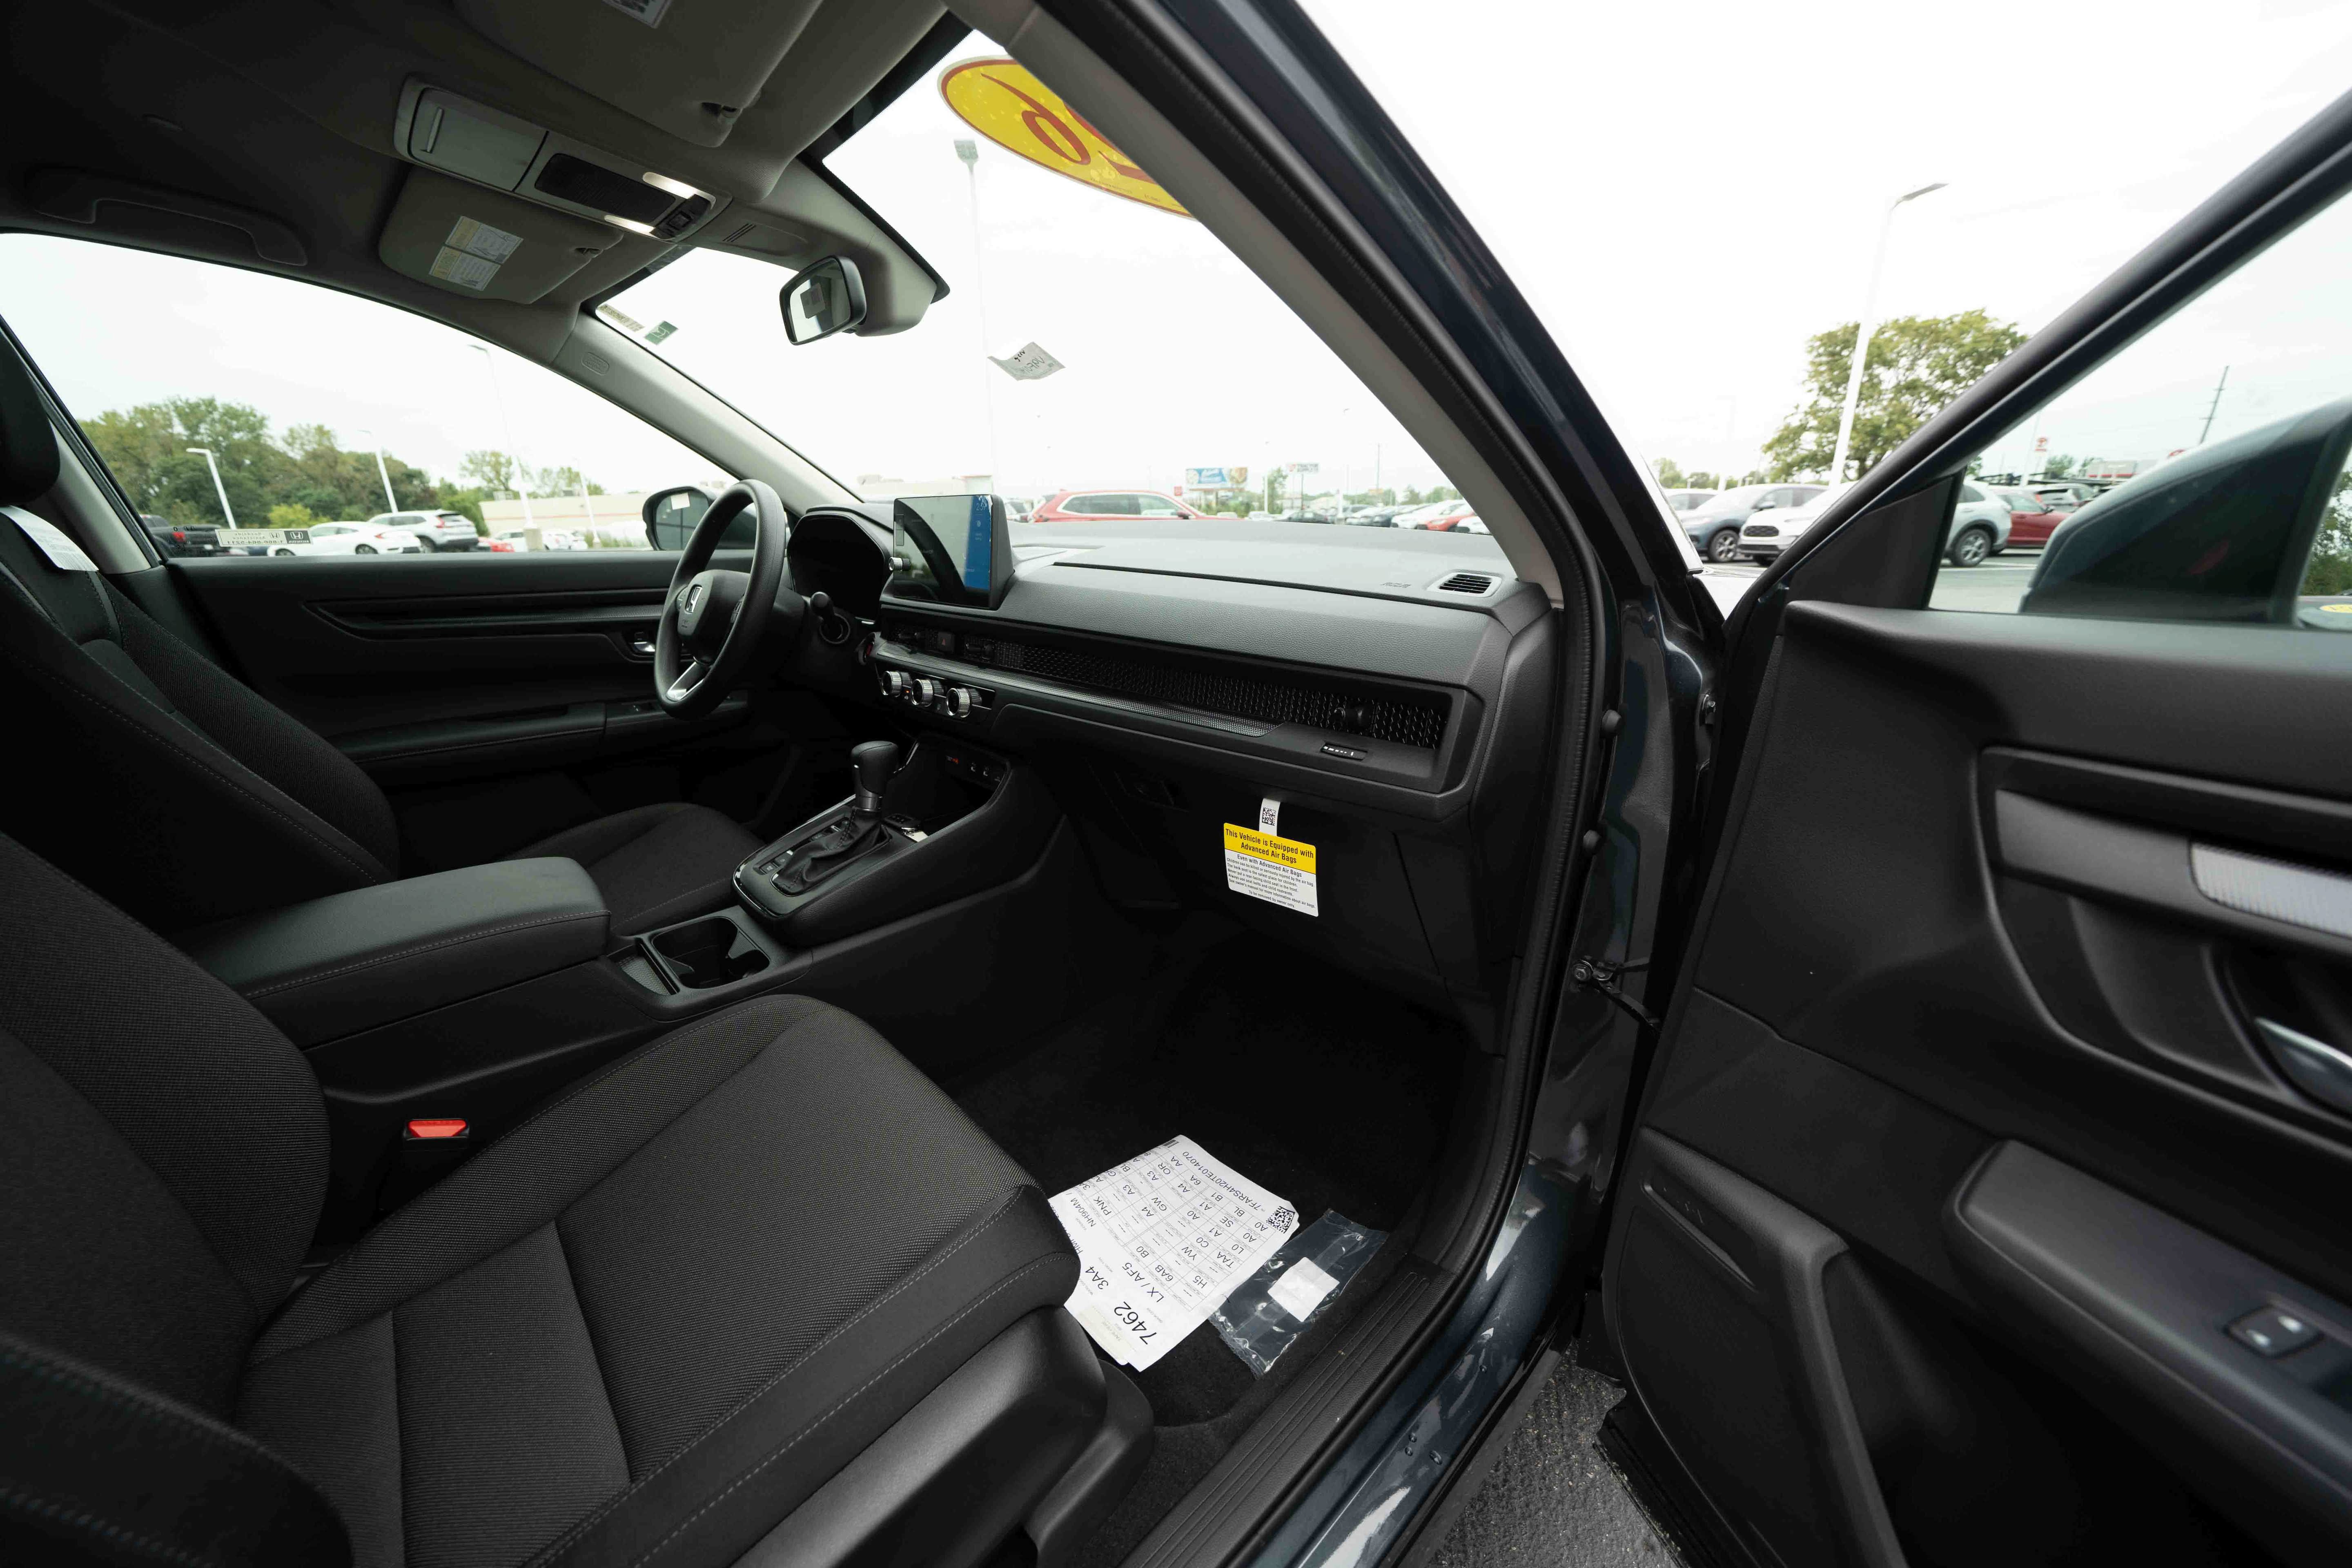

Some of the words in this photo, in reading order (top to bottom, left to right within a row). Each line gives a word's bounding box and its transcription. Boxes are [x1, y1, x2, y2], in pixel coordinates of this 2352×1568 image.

[1225, 829, 1237, 837] This
[1239, 832, 1261, 844] Vehicle
[1270, 840, 1298, 854] Equipped
[1300, 850, 1313, 858] with
[1241, 842, 1269, 856] Advanced
[1282, 853, 1296, 863] Bags
[1260, 861, 1281, 871] Advanced
[1273, 892, 1291, 900] information
[1171, 1156, 1183, 1166] AA
[1158, 1162, 1170, 1174] OR
[1147, 1171, 1159, 1180] A3
[1183, 1152, 1261, 1210] 7FARS4H20TE014070
[1190, 1175, 1200, 1185] 6A
[1123, 1185, 1135, 1194] A3
[1178, 1183, 1190, 1192] A4
[1211, 1192, 1223, 1201] B1
[1094, 1196, 1111, 1215] PNK
[1151, 1197, 1167, 1211] GW
[1199, 1202, 1212, 1210] A1
[1070, 1198, 1096, 1227] NH904M
[1141, 1207, 1154, 1216] A4
[1234, 1206, 1245, 1216] BL
[1219, 1216, 1233, 1227] SE
[1209, 1227, 1222, 1236] A1
[1136, 1246, 1149, 1258] B0
[1181, 1247, 1197, 1260] YW
[1217, 1251, 1234, 1268] TAA
[1085, 1266, 1108, 1289] 3A4
[1122, 1263, 1145, 1281] AF5
[1155, 1265, 1173, 1281] 6AB
[1192, 1276, 1207, 1288] H5
[1146, 1287, 1164, 1302] LX
[1114, 1301, 1156, 1344] 7462
